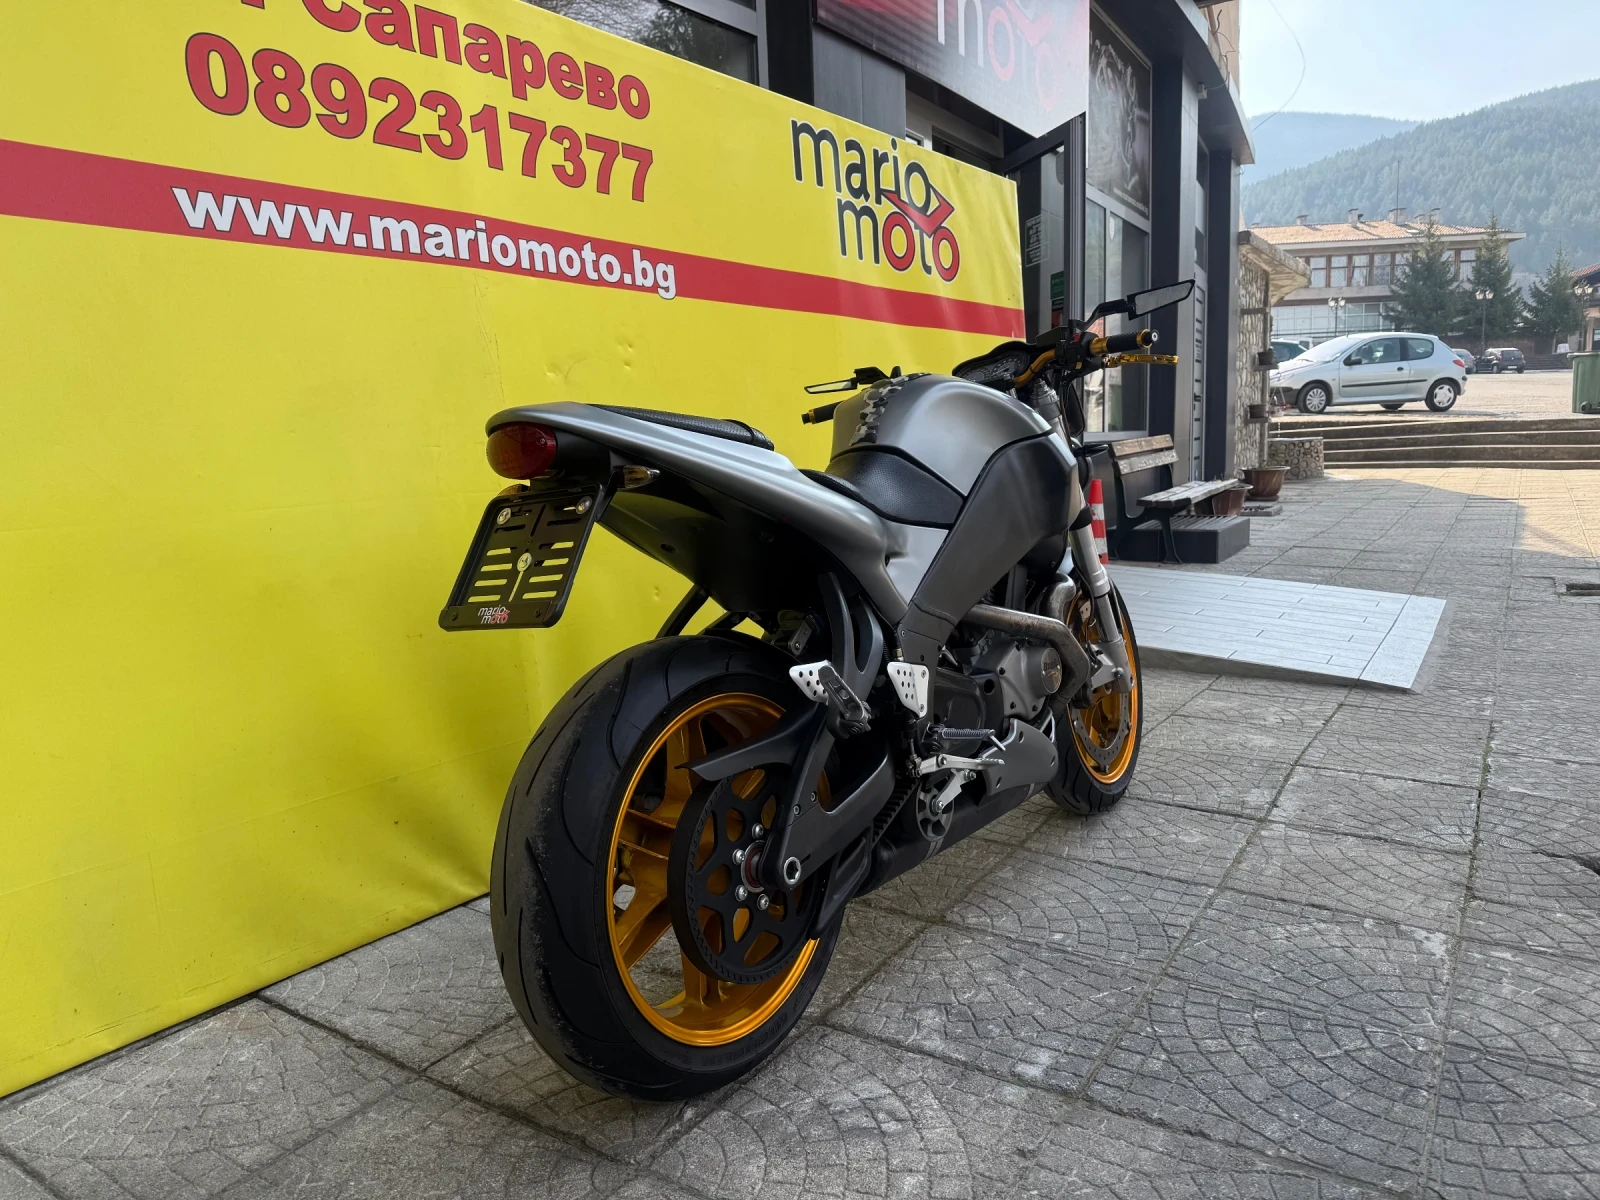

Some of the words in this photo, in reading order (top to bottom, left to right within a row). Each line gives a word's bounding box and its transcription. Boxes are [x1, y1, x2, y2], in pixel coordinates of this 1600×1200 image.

[185, 32, 654, 202] 0892317377
[790, 118, 932, 217] mario
[171, 187, 677, 300] www.mariomoto.bg
[836, 197, 961, 283] moto
[477, 604, 507, 616] mario
[480, 614, 509, 625] moto
